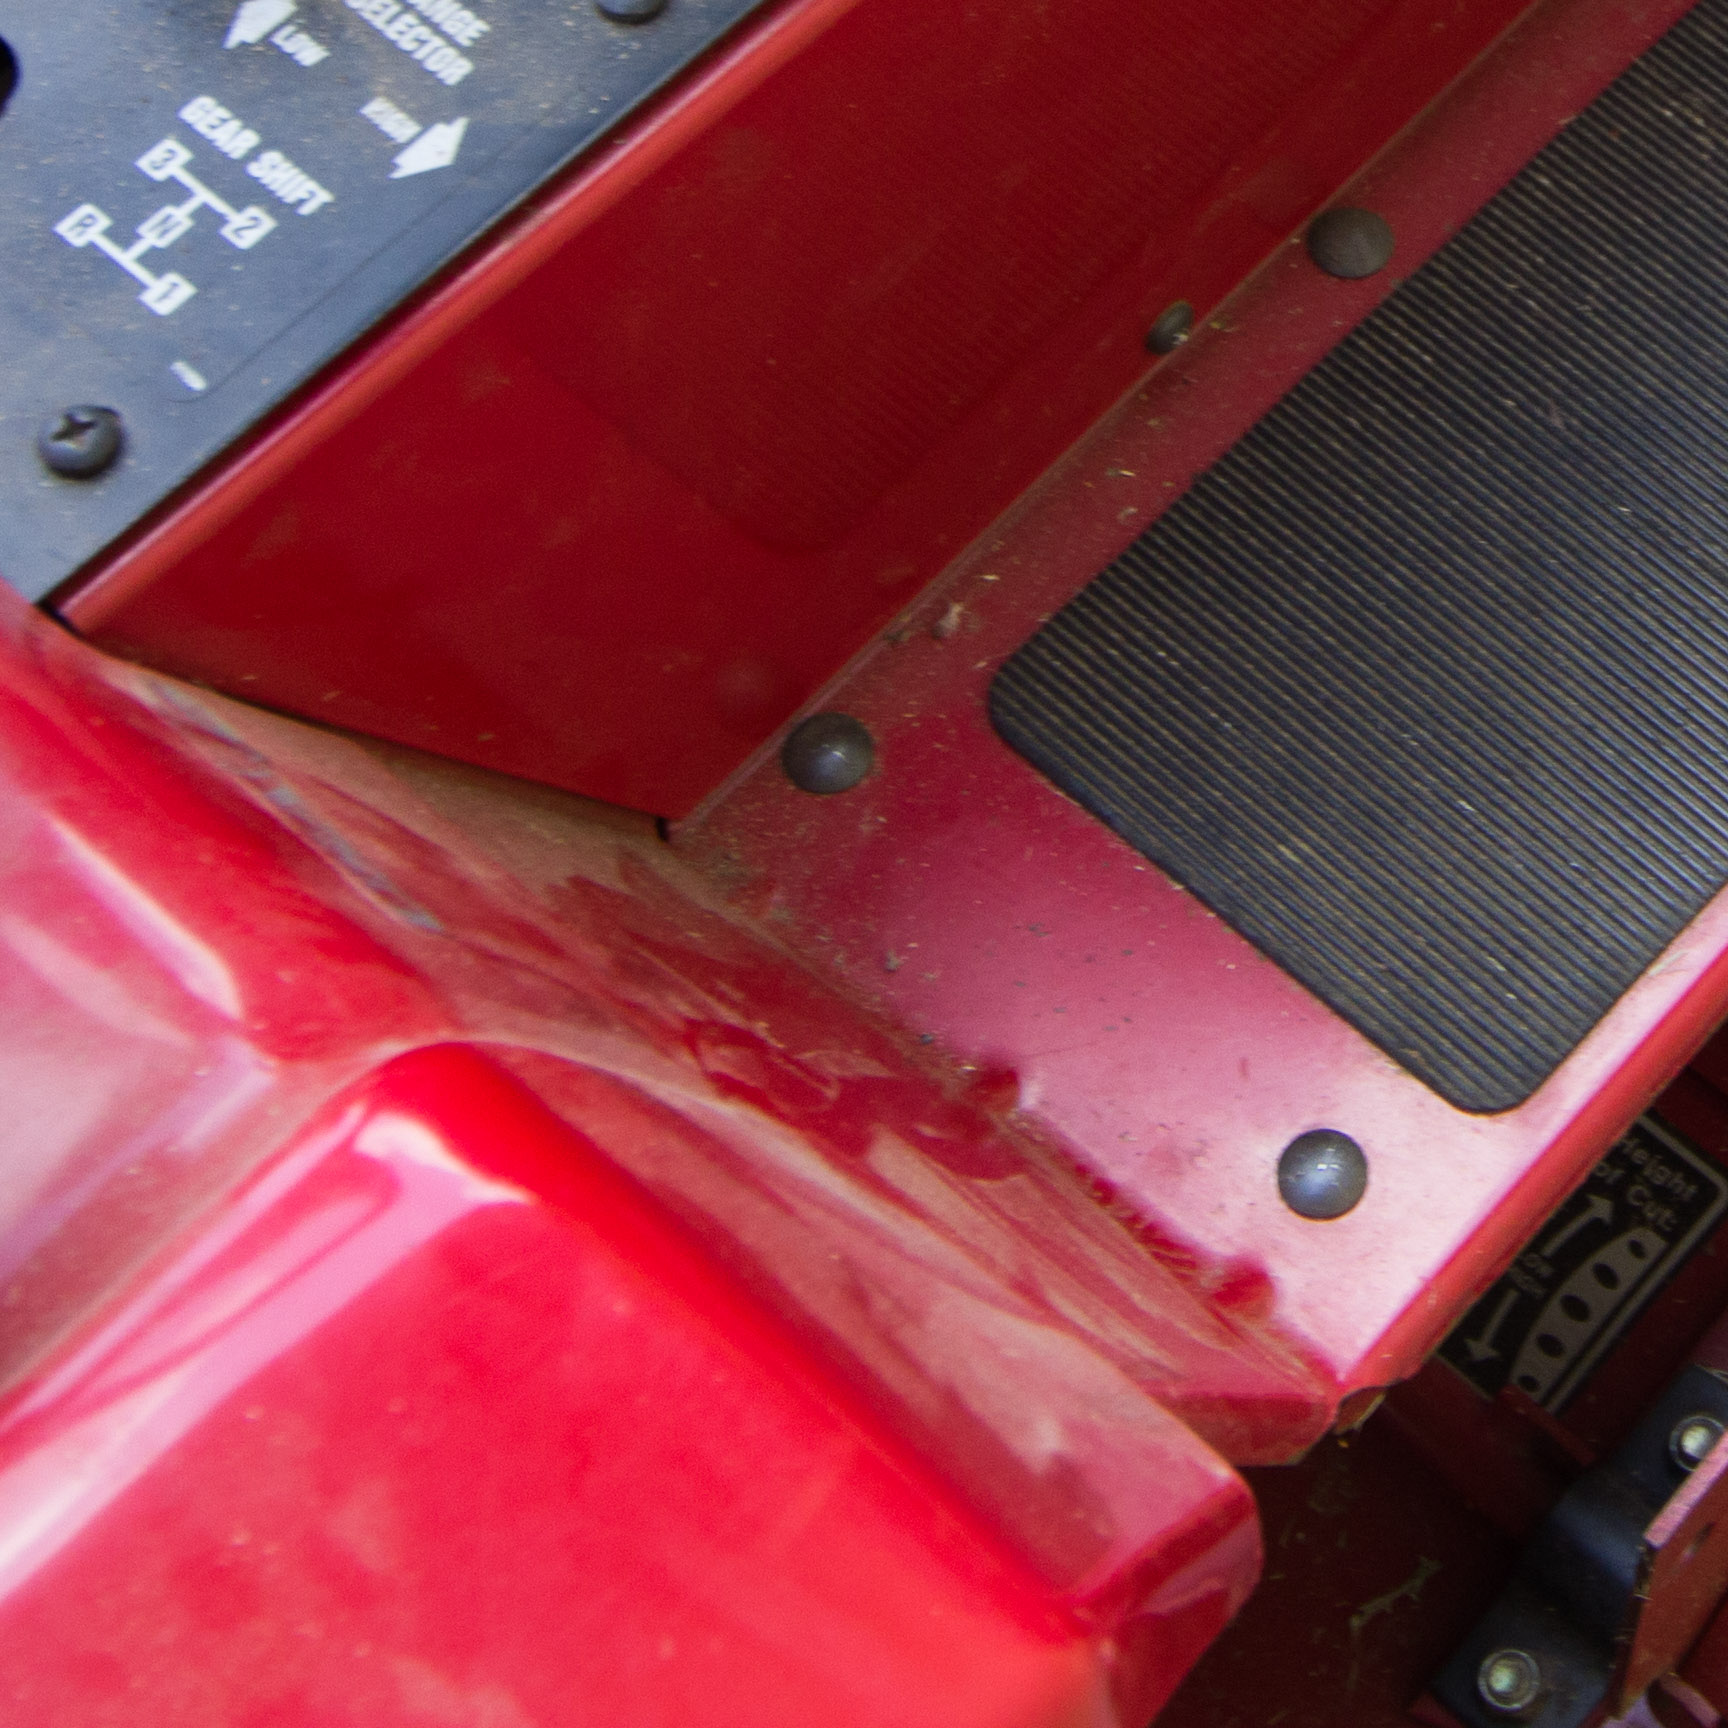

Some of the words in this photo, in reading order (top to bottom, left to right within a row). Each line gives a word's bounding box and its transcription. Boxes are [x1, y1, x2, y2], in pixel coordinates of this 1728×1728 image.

[178, 96, 261, 160] GEAR
[246, 151, 334, 215] SHIFT
[1627, 1184, 1677, 1234] Cut
